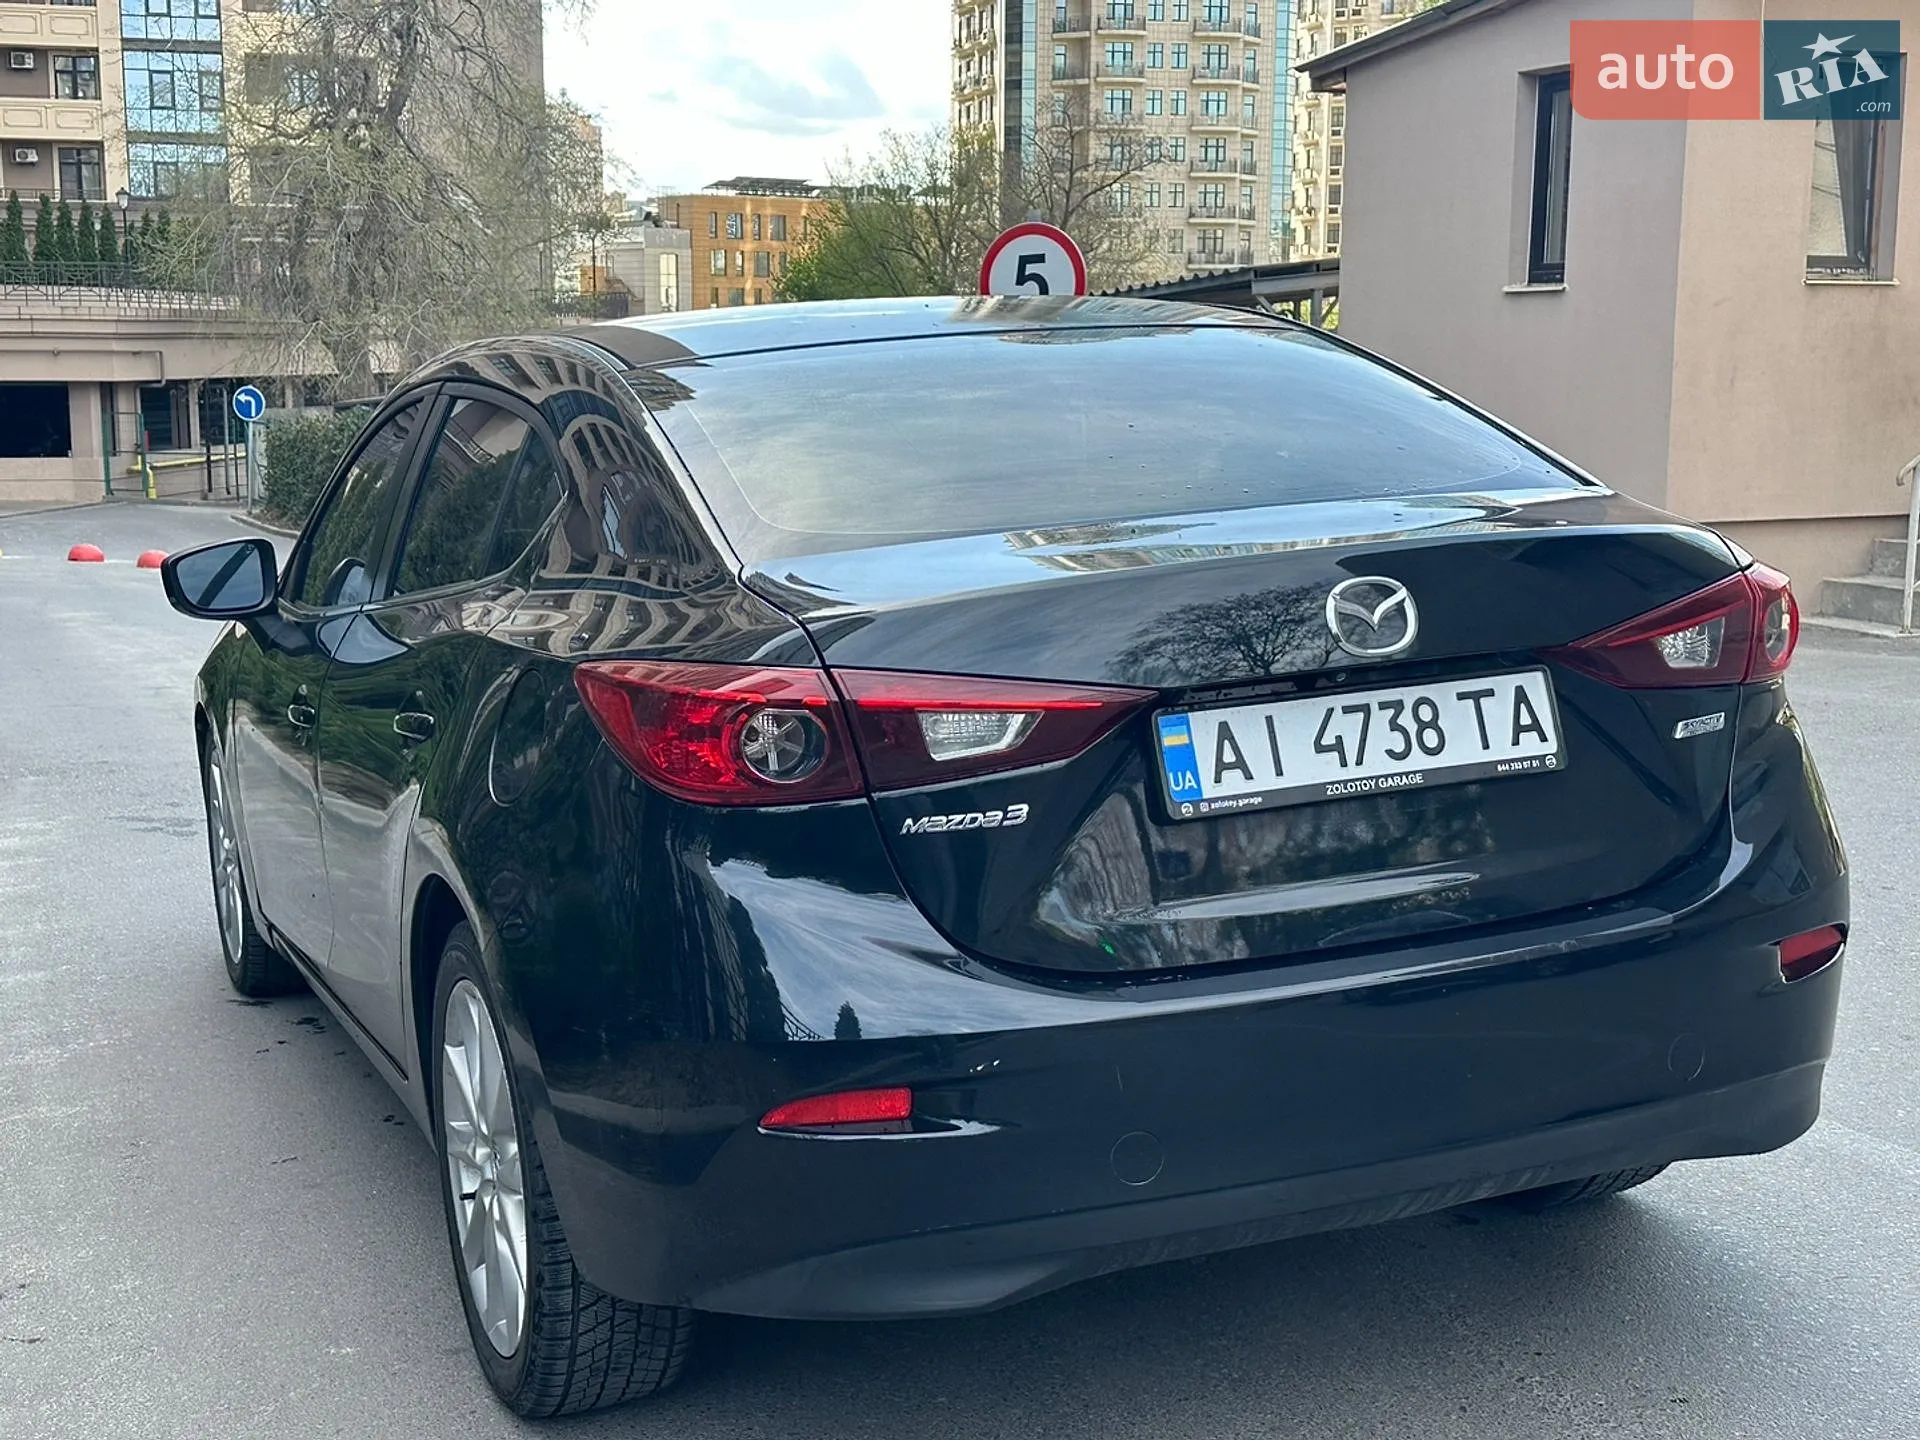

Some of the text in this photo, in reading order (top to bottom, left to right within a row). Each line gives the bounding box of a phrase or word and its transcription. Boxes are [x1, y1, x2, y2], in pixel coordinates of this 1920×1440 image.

[1015, 253, 1049, 295] 5
[1213, 684, 1550, 784] AI 4738 TA
[1169, 770, 1198, 791] UA
[1325, 773, 1425, 795] ZOLOTOY GARAGE
